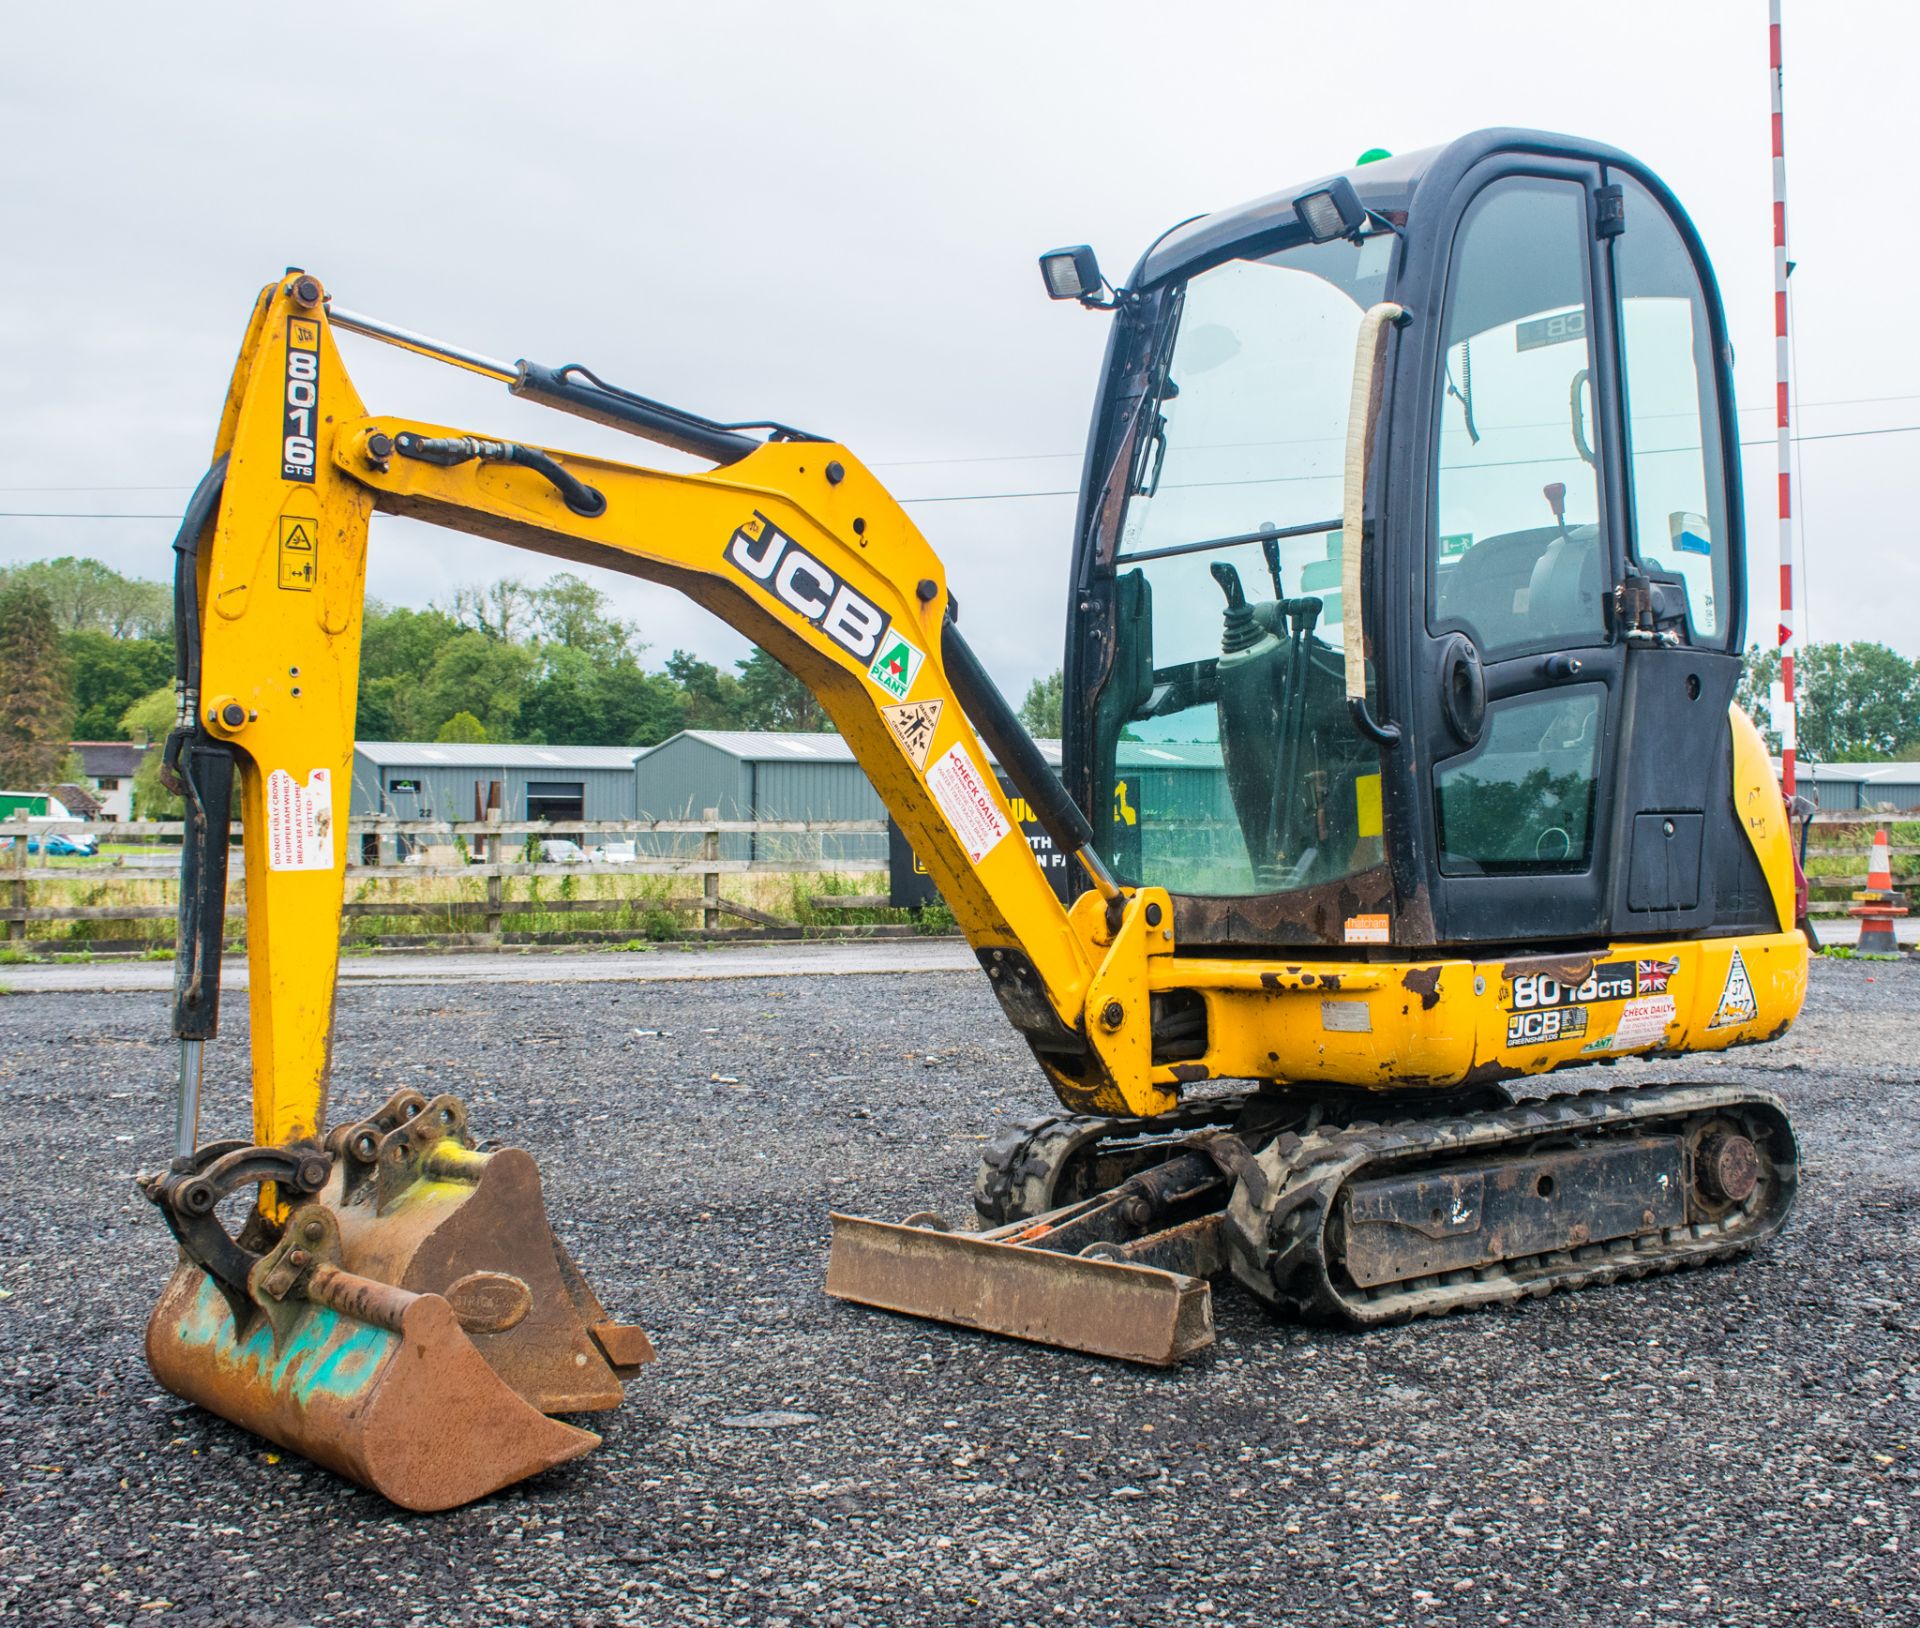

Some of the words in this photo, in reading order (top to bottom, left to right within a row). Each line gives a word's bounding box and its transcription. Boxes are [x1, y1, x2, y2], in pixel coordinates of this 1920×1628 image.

[285, 352, 316, 466] 8016
[284, 464, 312, 477] CTS
[732, 533, 884, 658] JCB
[879, 642, 910, 684] A
[871, 666, 908, 698] PLANT
[918, 704, 934, 727] DANGER
[891, 720, 905, 740] CRUSH
[903, 740, 914, 756] AREA
[953, 756, 979, 796] CHECK
[977, 797, 1000, 830] DAILY
[419, 808, 432, 818] 22
[274, 852, 280, 863] DO
[1509, 1011, 1561, 1039] JCB
[1624, 1006, 1648, 1018] CHECK
[1650, 1004, 1671, 1015] DAILY
